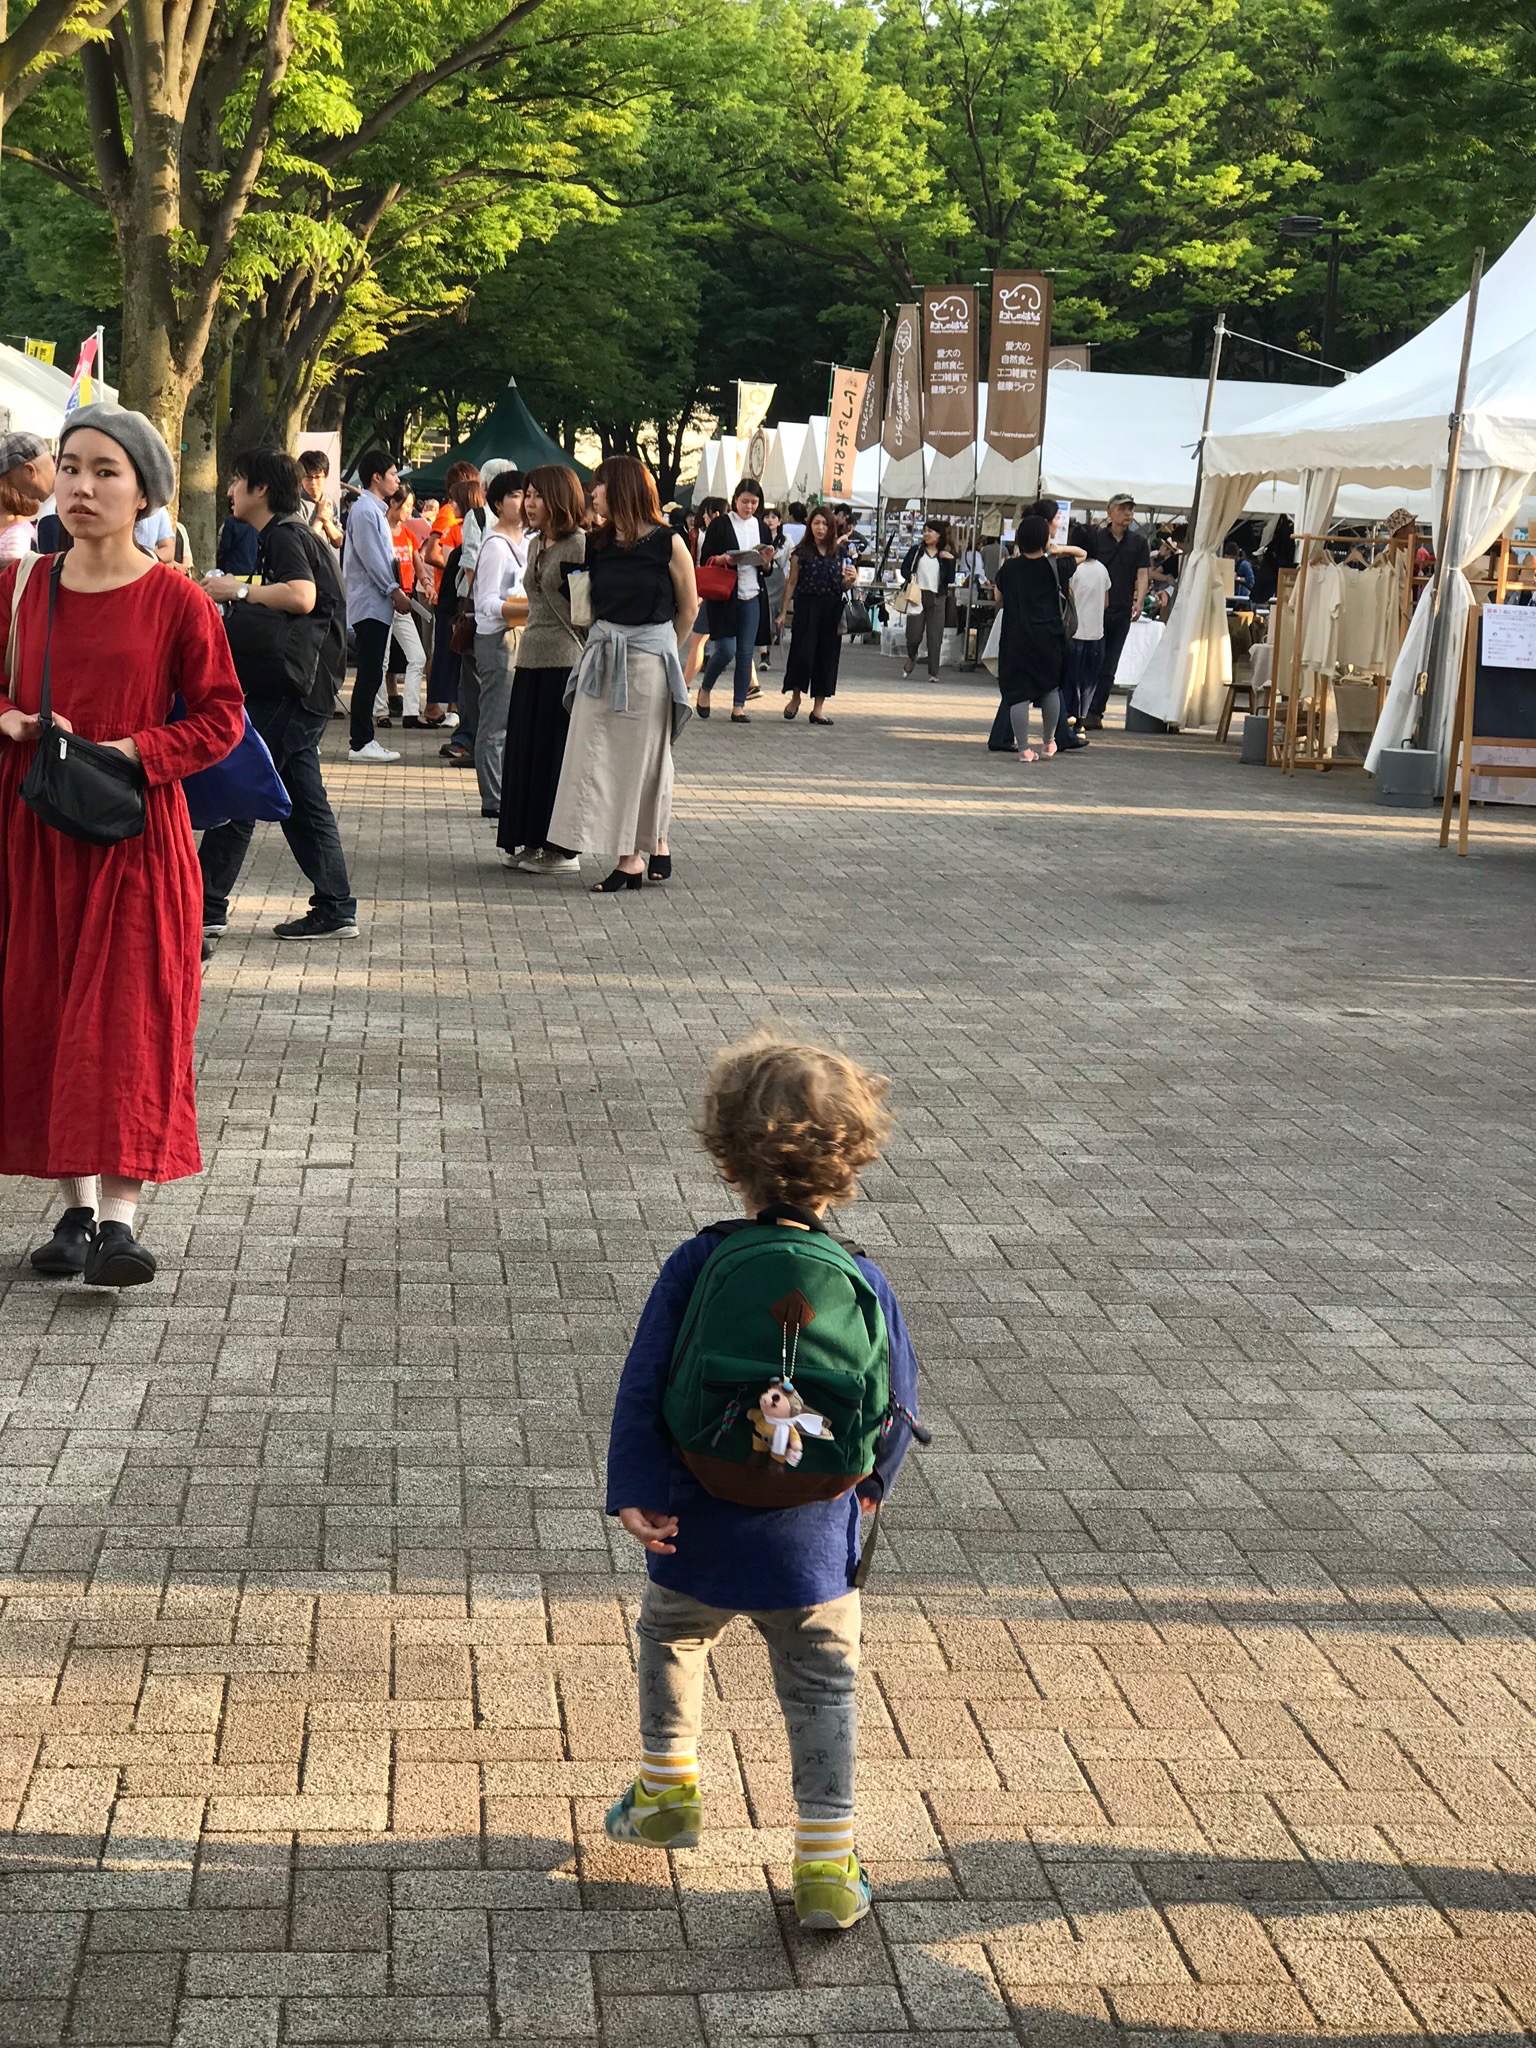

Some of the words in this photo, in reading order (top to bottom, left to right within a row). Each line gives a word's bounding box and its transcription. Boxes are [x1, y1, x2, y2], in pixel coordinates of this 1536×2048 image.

[1005, 341, 1031, 352] 愛犬の
[937, 349, 961, 358] 愛犬の
[1001, 354, 1034, 365] 自然食と
[933, 361, 964, 370] 自然食と
[930, 373, 968, 382] エコ雑貨で
[997, 368, 1037, 379] エコ雑貨で
[931, 385, 967, 394] 健康ライフ
[997, 381, 1036, 392] 健康ライフ
